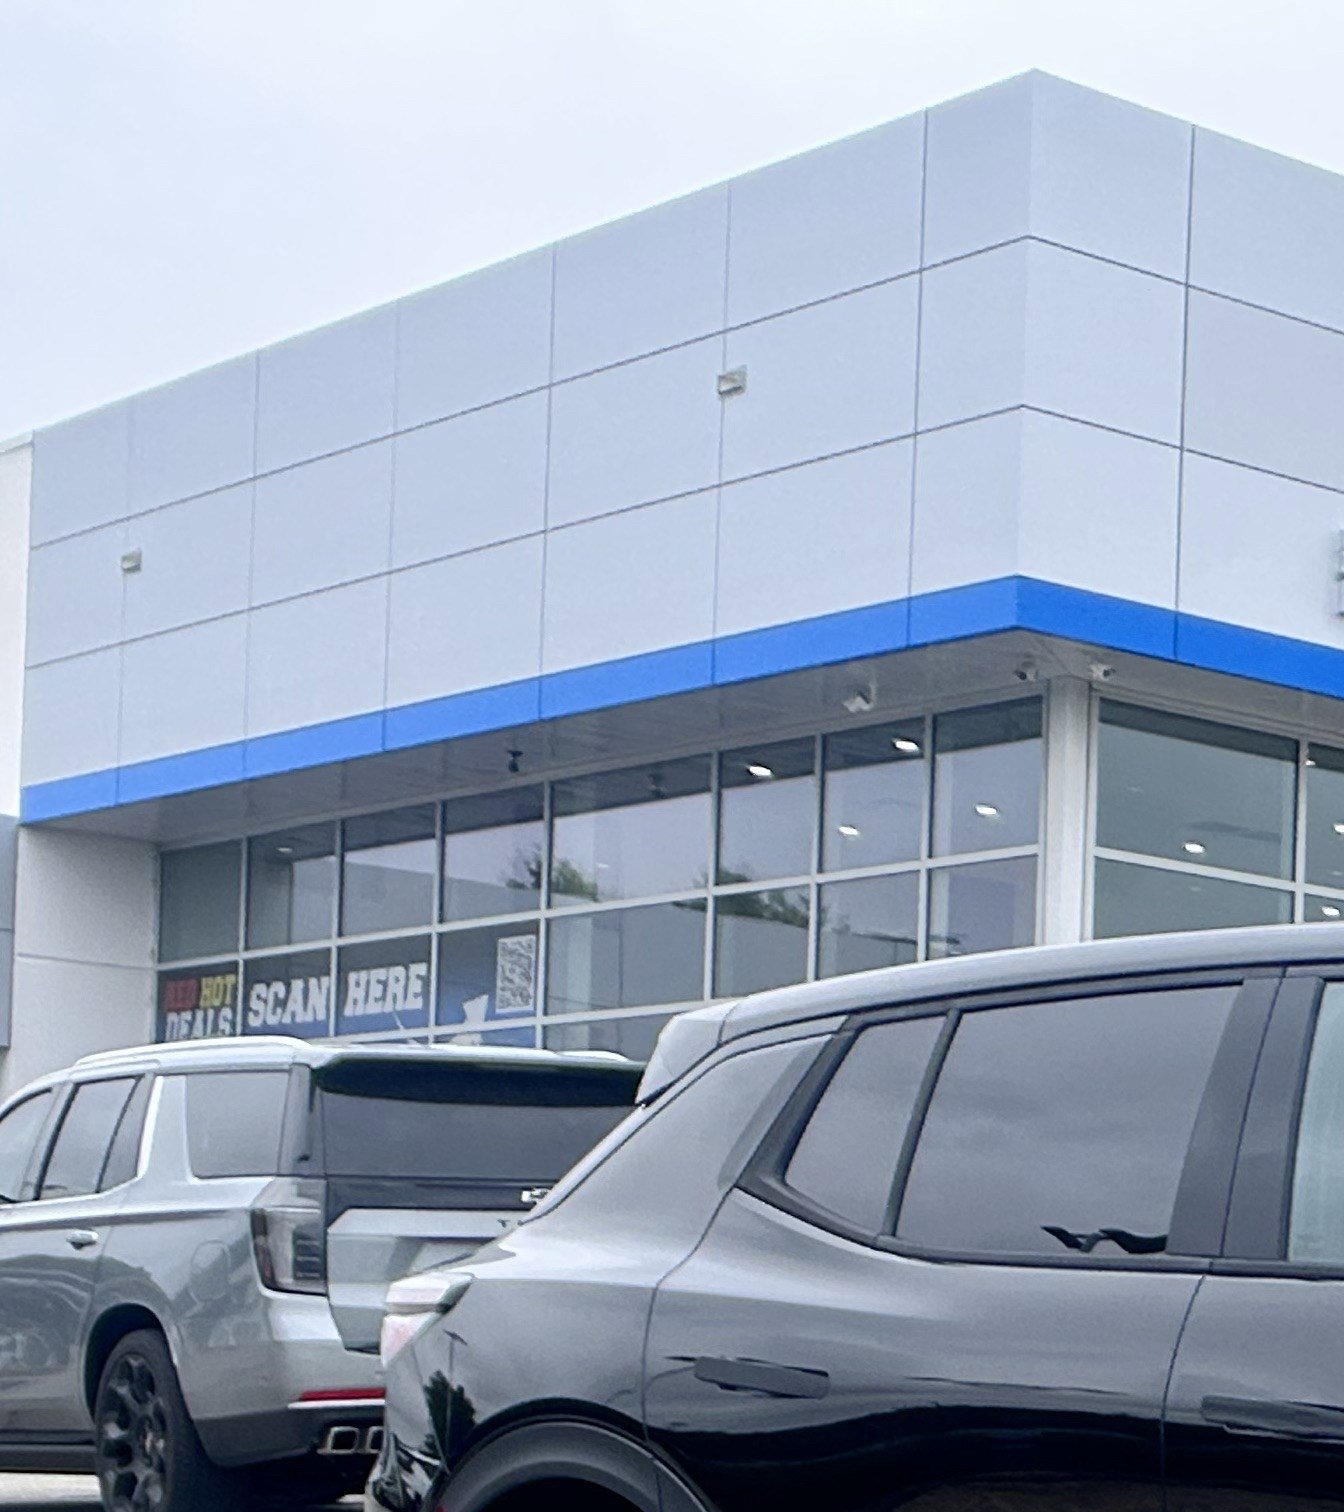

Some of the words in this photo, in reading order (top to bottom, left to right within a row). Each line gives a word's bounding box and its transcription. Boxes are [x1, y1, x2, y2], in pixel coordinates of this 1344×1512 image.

[200, 974, 237, 1008] HOT
[247, 975, 331, 1028] SCAN
[343, 962, 427, 1017] HERE
